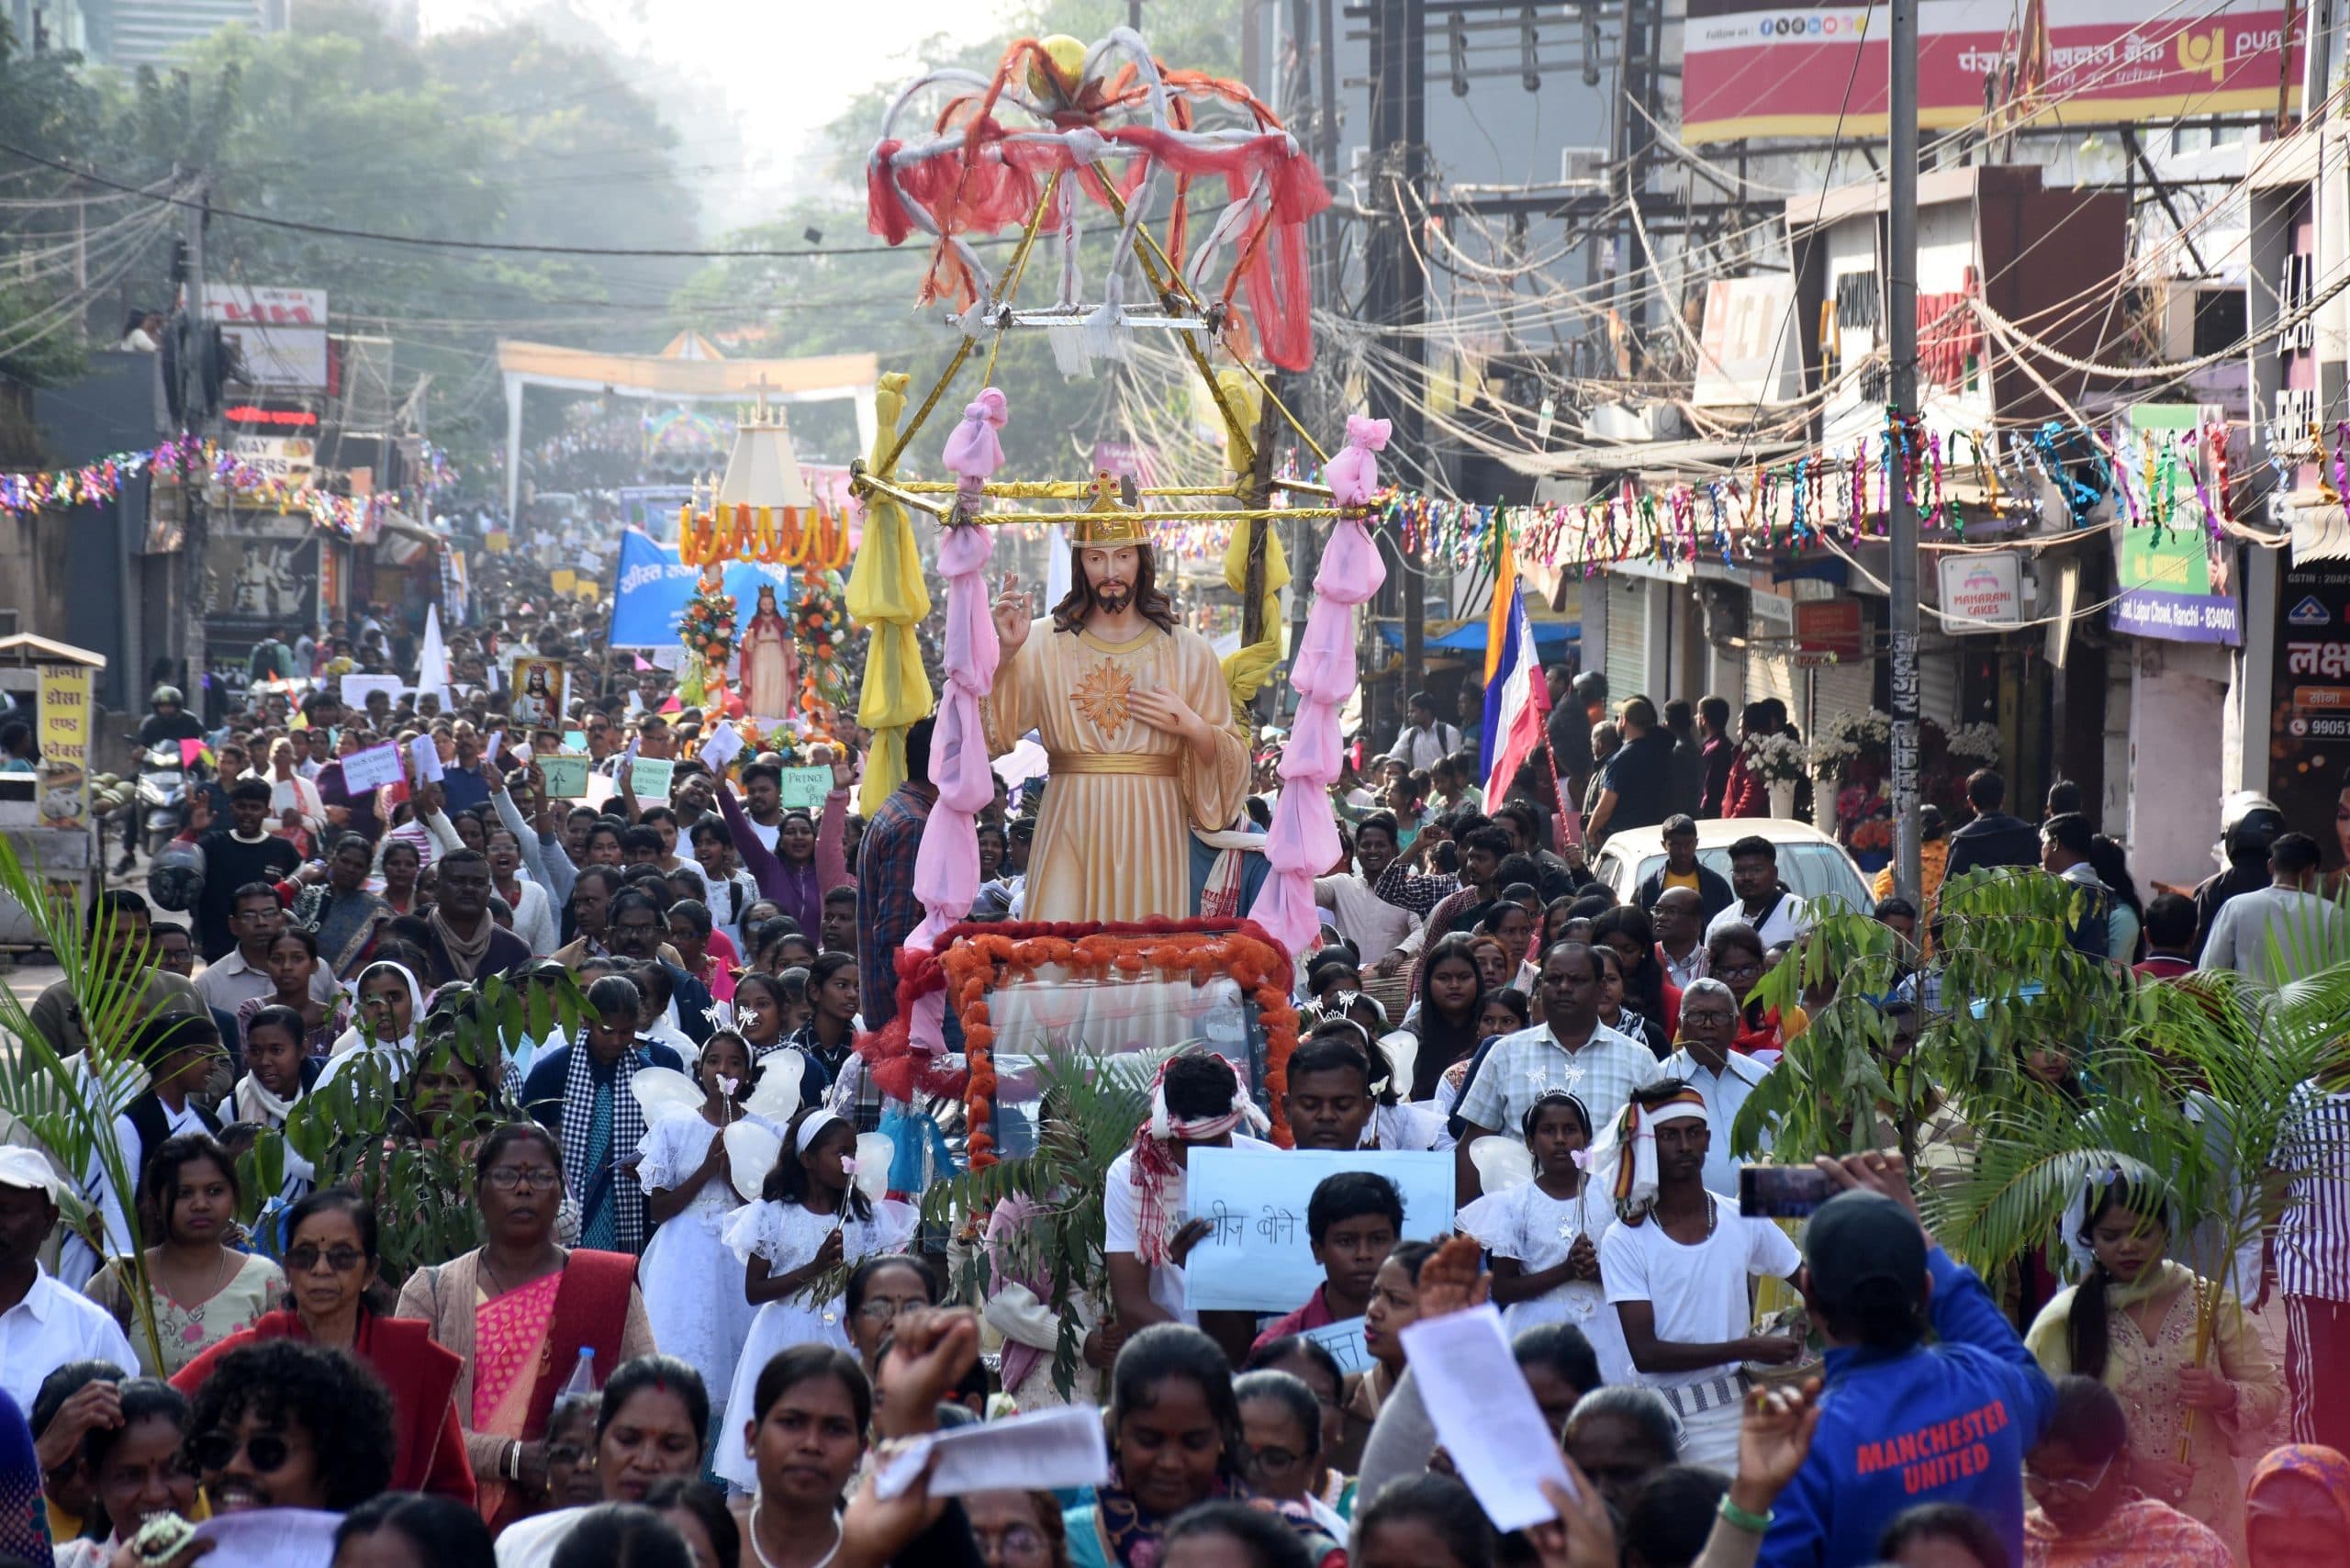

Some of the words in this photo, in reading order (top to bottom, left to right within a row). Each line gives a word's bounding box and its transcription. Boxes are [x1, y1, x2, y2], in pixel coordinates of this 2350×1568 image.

[1953, 590, 2011, 606] MAHARANI
[1967, 604, 1999, 616] CAKES
[2173, 602, 2199, 626] Ranchi
[2206, 606, 2236, 631] 834001
[46, 688, 82, 706] डोसा
[2309, 690, 2341, 704] सोना
[789, 771, 823, 783] PRINCE
[1257, 1204, 1303, 1246] बोने
[1856, 1399, 2009, 1475] MANCHESTER
[1903, 1442, 1990, 1495] UNITED
